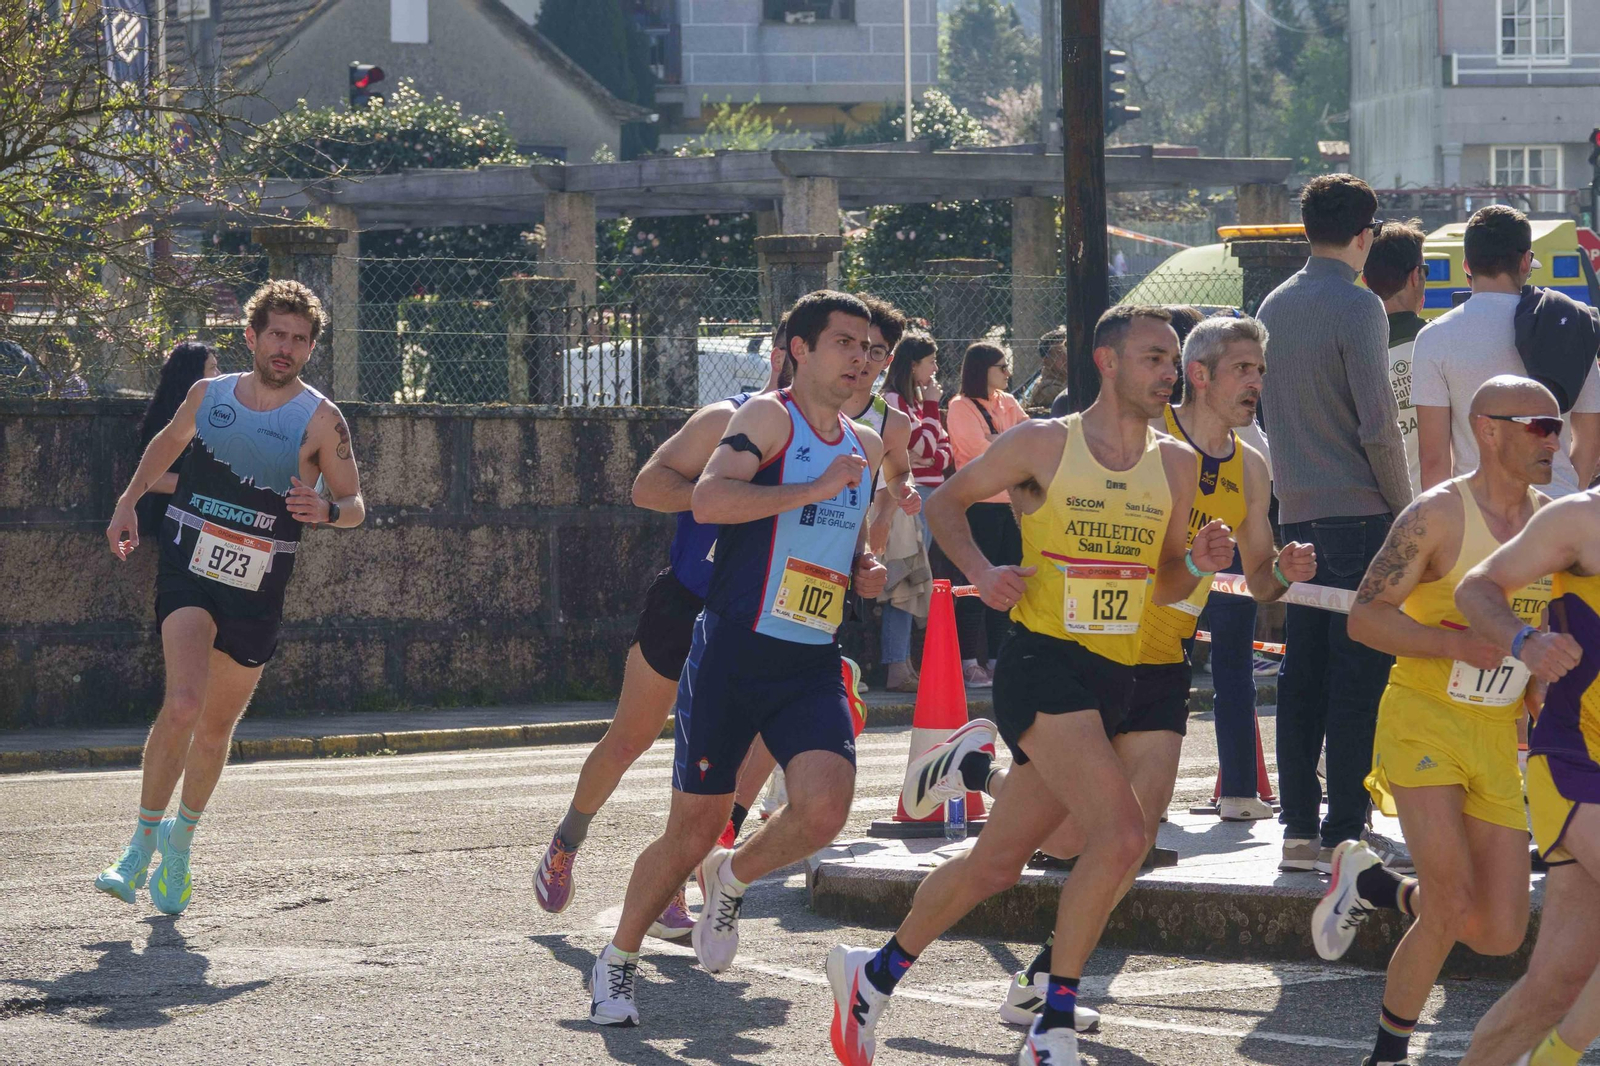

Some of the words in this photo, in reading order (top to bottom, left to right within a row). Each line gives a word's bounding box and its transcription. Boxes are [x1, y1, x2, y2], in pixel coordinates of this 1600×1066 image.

[818, 508, 845, 520] XUNTA
[1126, 502, 1140, 511] San
[816, 516, 826, 525] DE
[828, 518, 856, 530] GALICIA
[1065, 520, 1156, 546] ATHLETICS
[1078, 538, 1103, 554] San
[1106, 541, 1141, 557] Lázaro
[208, 545, 251, 578] 923
[799, 584, 834, 619] 102
[1092, 590, 1128, 620] 132
